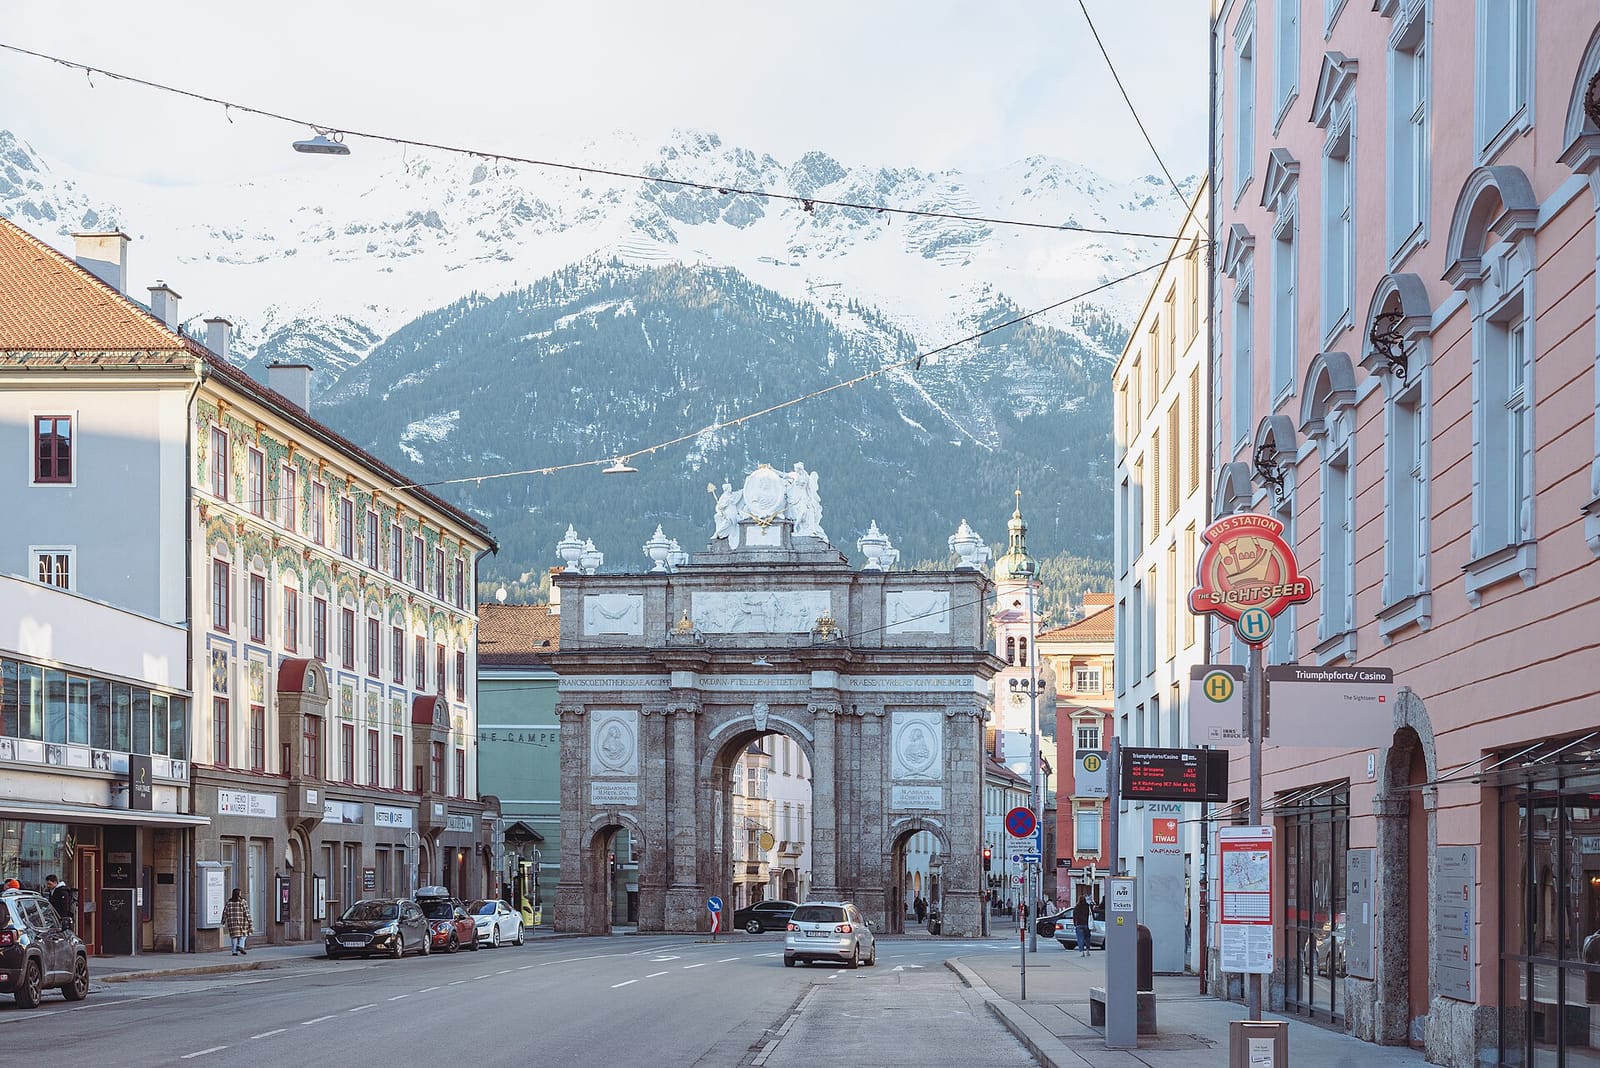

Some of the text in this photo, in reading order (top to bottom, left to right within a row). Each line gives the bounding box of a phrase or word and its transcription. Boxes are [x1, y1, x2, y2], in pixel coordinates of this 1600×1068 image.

[1209, 516, 1278, 538] BUS STATION
[1210, 582, 1306, 605] SIGHTSEER
[1246, 613, 1264, 634] H
[1295, 670, 1386, 682] Triumphpforte/ Casino
[1211, 678, 1226, 697] H
[508, 733, 560, 742] CAMPE
[1088, 758, 1097, 769] H
[1155, 834, 1176, 842] TIWAG
